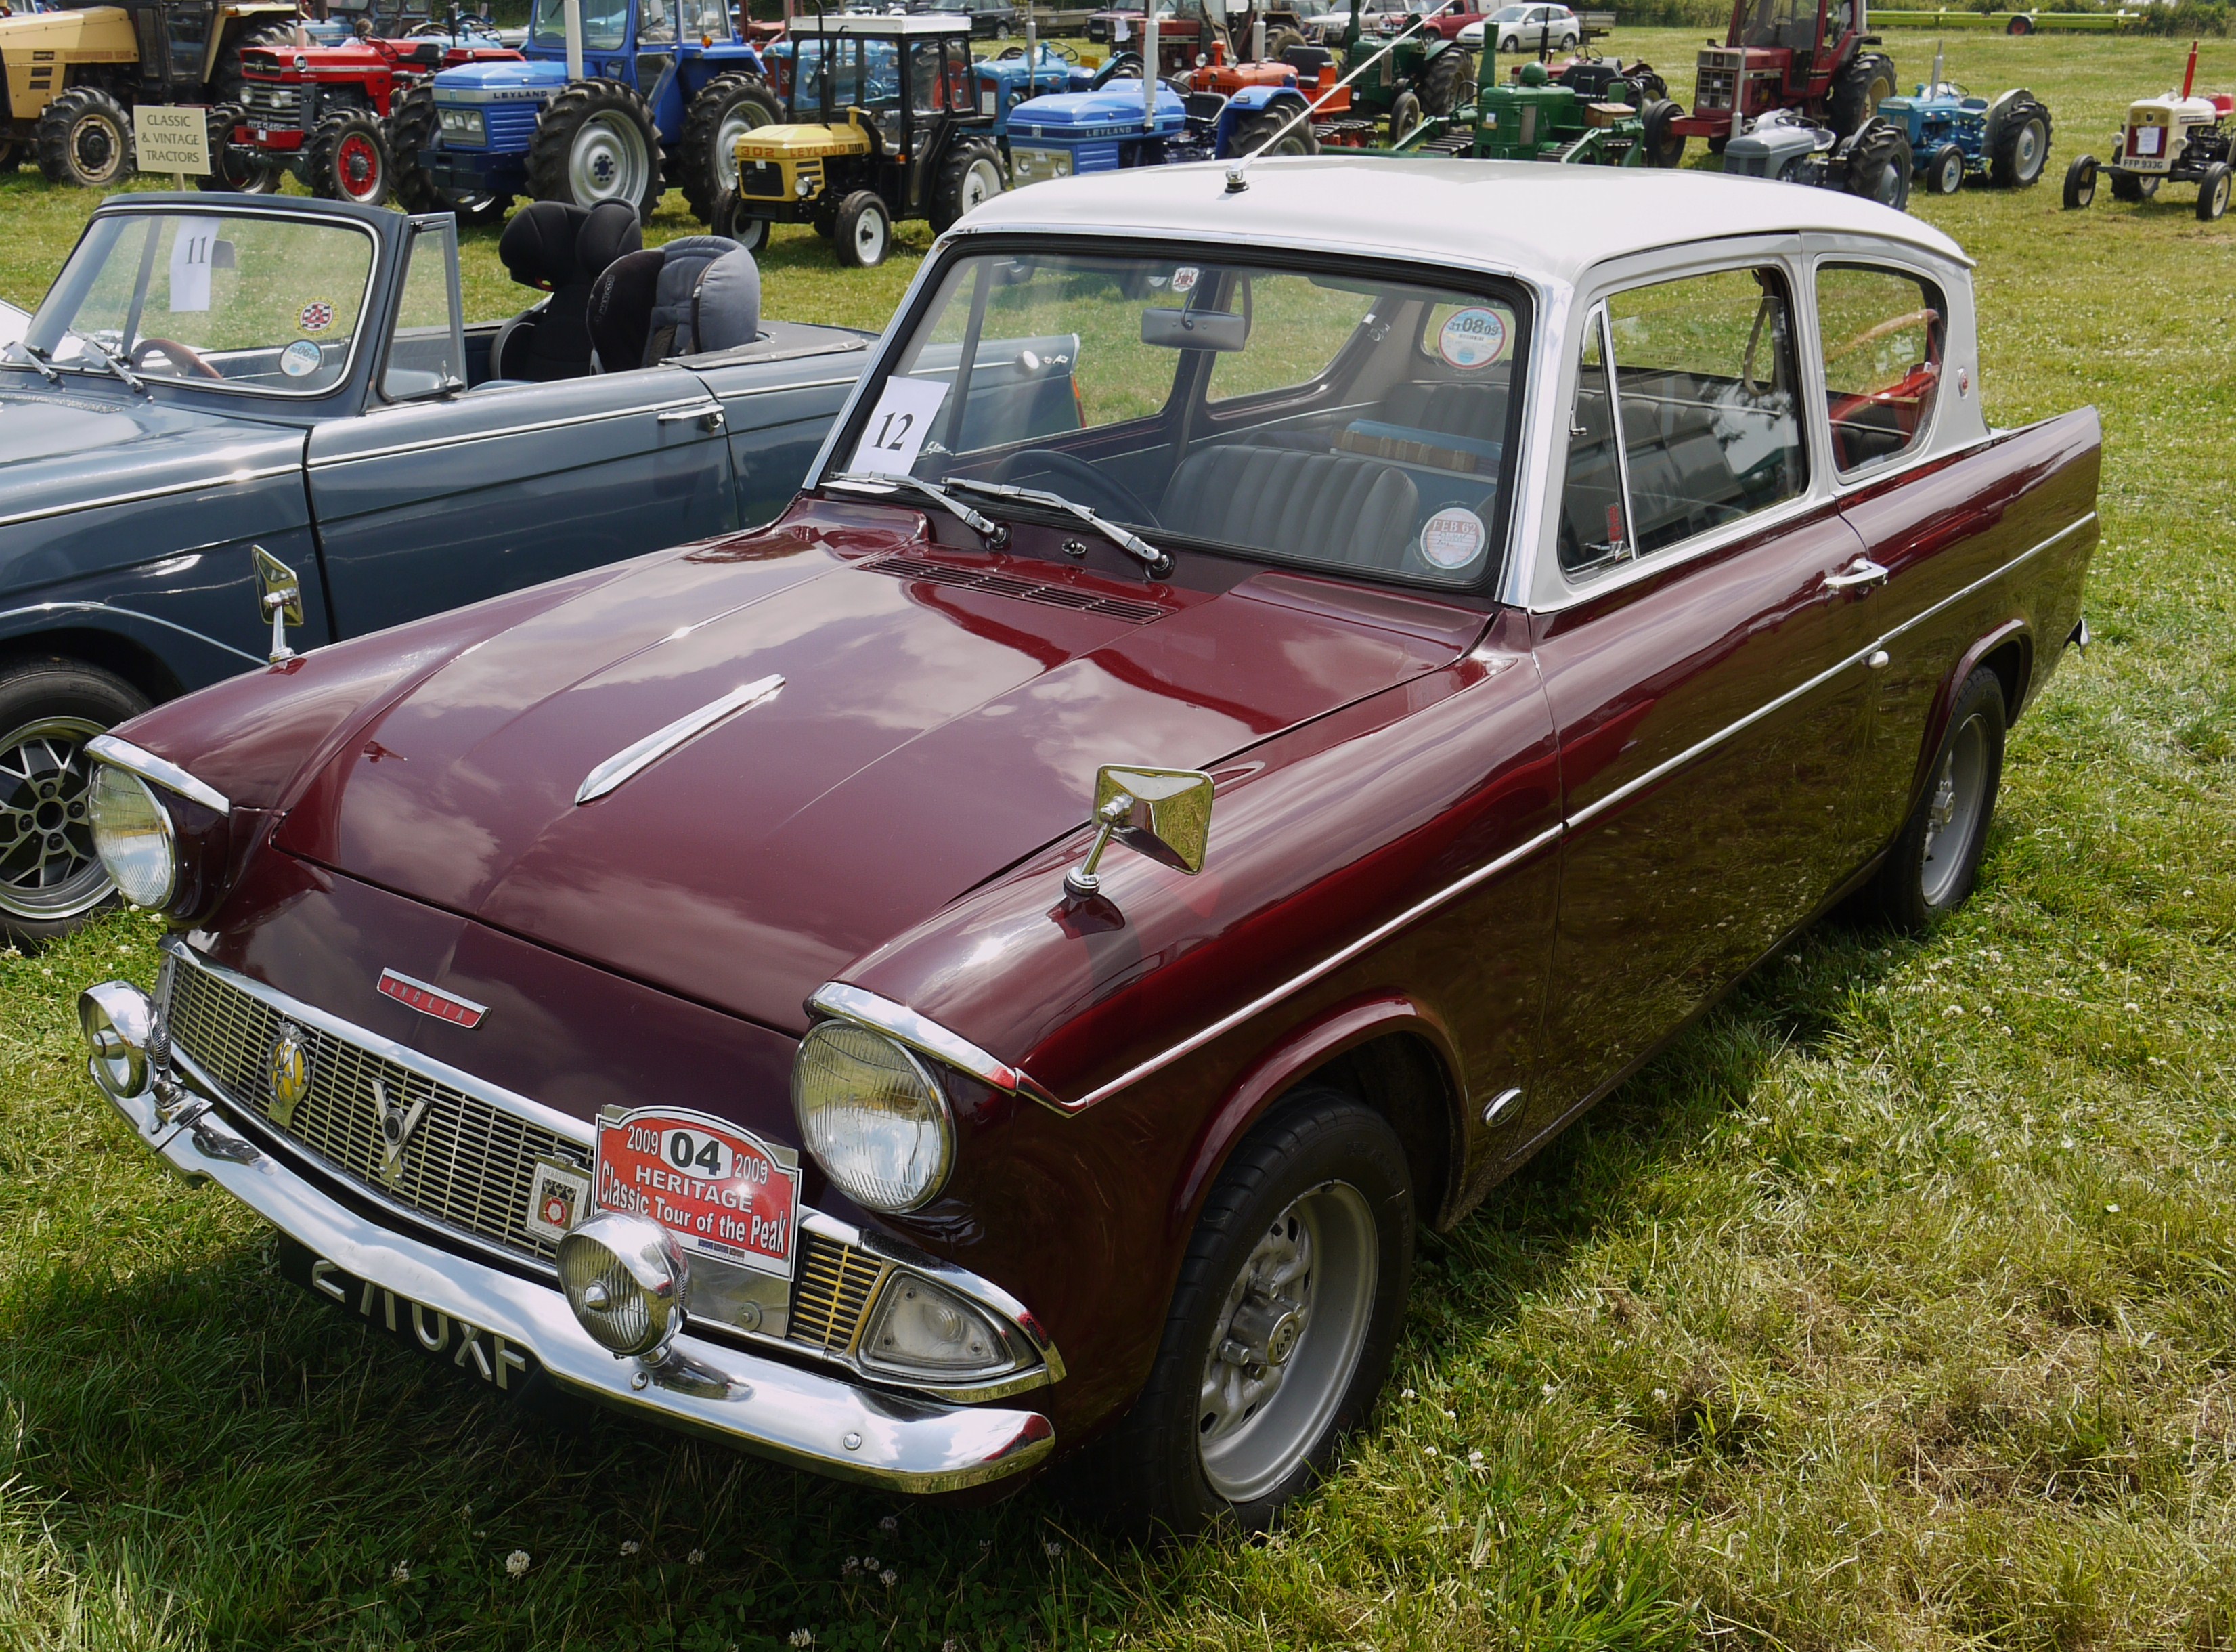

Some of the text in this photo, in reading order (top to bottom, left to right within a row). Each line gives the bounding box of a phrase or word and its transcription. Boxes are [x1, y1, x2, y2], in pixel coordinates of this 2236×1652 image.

[493, 90, 548, 99] LEYLAND
[147, 114, 191, 127] CLASSIC
[141, 132, 200, 146] & VINTAGE
[1086, 126, 1132, 137] LEYLAND
[146, 150, 200, 163] TRACTORS
[741, 144, 846, 157] 302 LEYLAND
[186, 236, 207, 264] 11
[1462, 318, 1485, 334] 08
[1484, 325, 1499, 336] 09
[871, 412, 913, 451] 12
[1433, 520, 1476, 534] FEB 62
[388, 982, 464, 1021] ANGLIA
[626, 1125, 768, 1185] 2009 04 2009
[543, 1167, 580, 1187] DERBYSHIRE
[636, 1165, 753, 1214] HERITAGE
[601, 1160, 787, 1253] Classic Tour of the Peak
